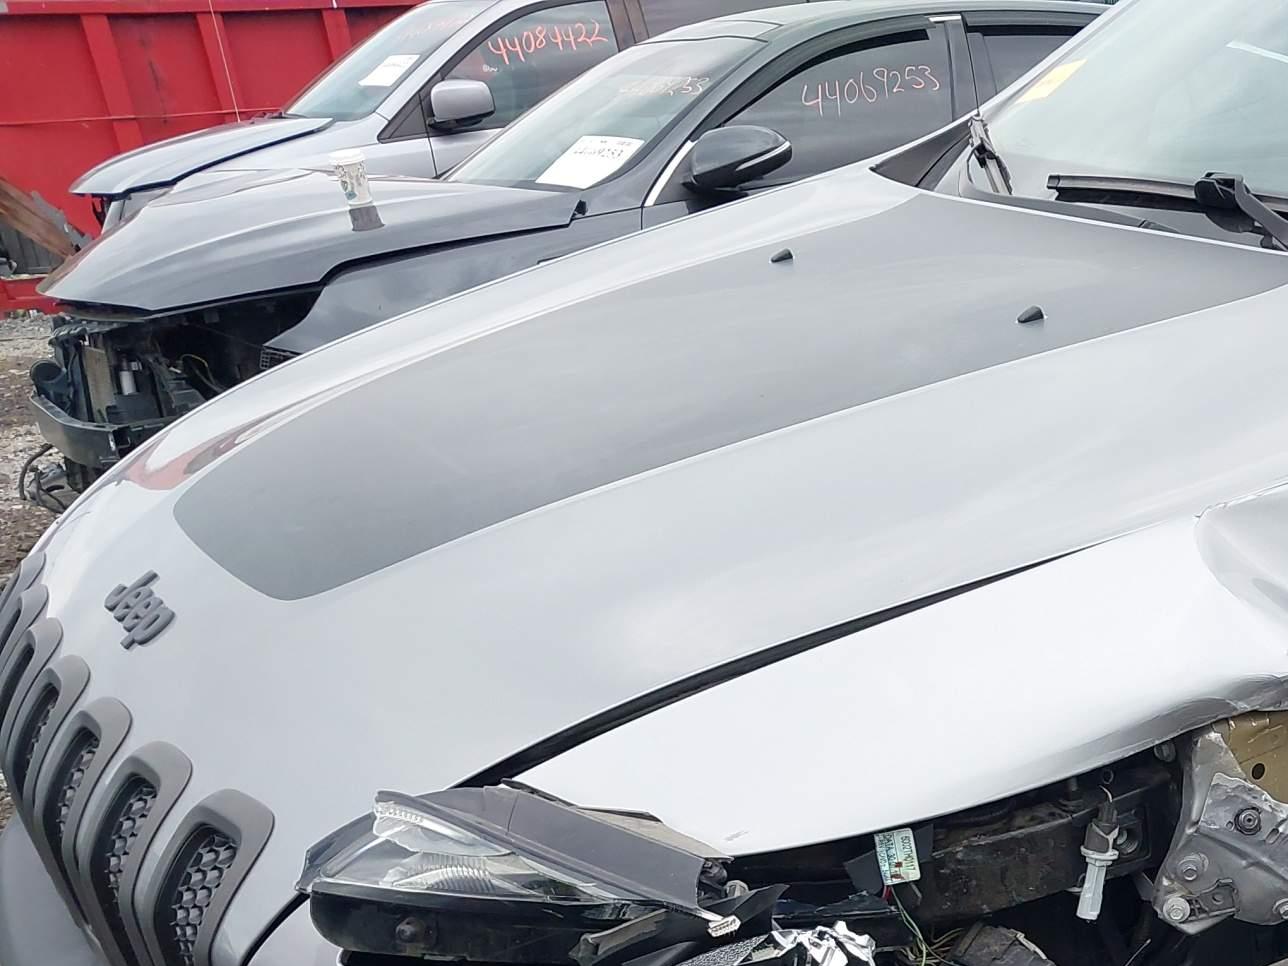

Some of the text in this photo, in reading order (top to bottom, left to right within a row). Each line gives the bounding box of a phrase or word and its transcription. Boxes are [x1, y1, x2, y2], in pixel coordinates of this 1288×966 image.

[488, 19, 608, 65] 44084422
[801, 64, 940, 117] 44069253
[104, 569, 176, 650] Jeep
